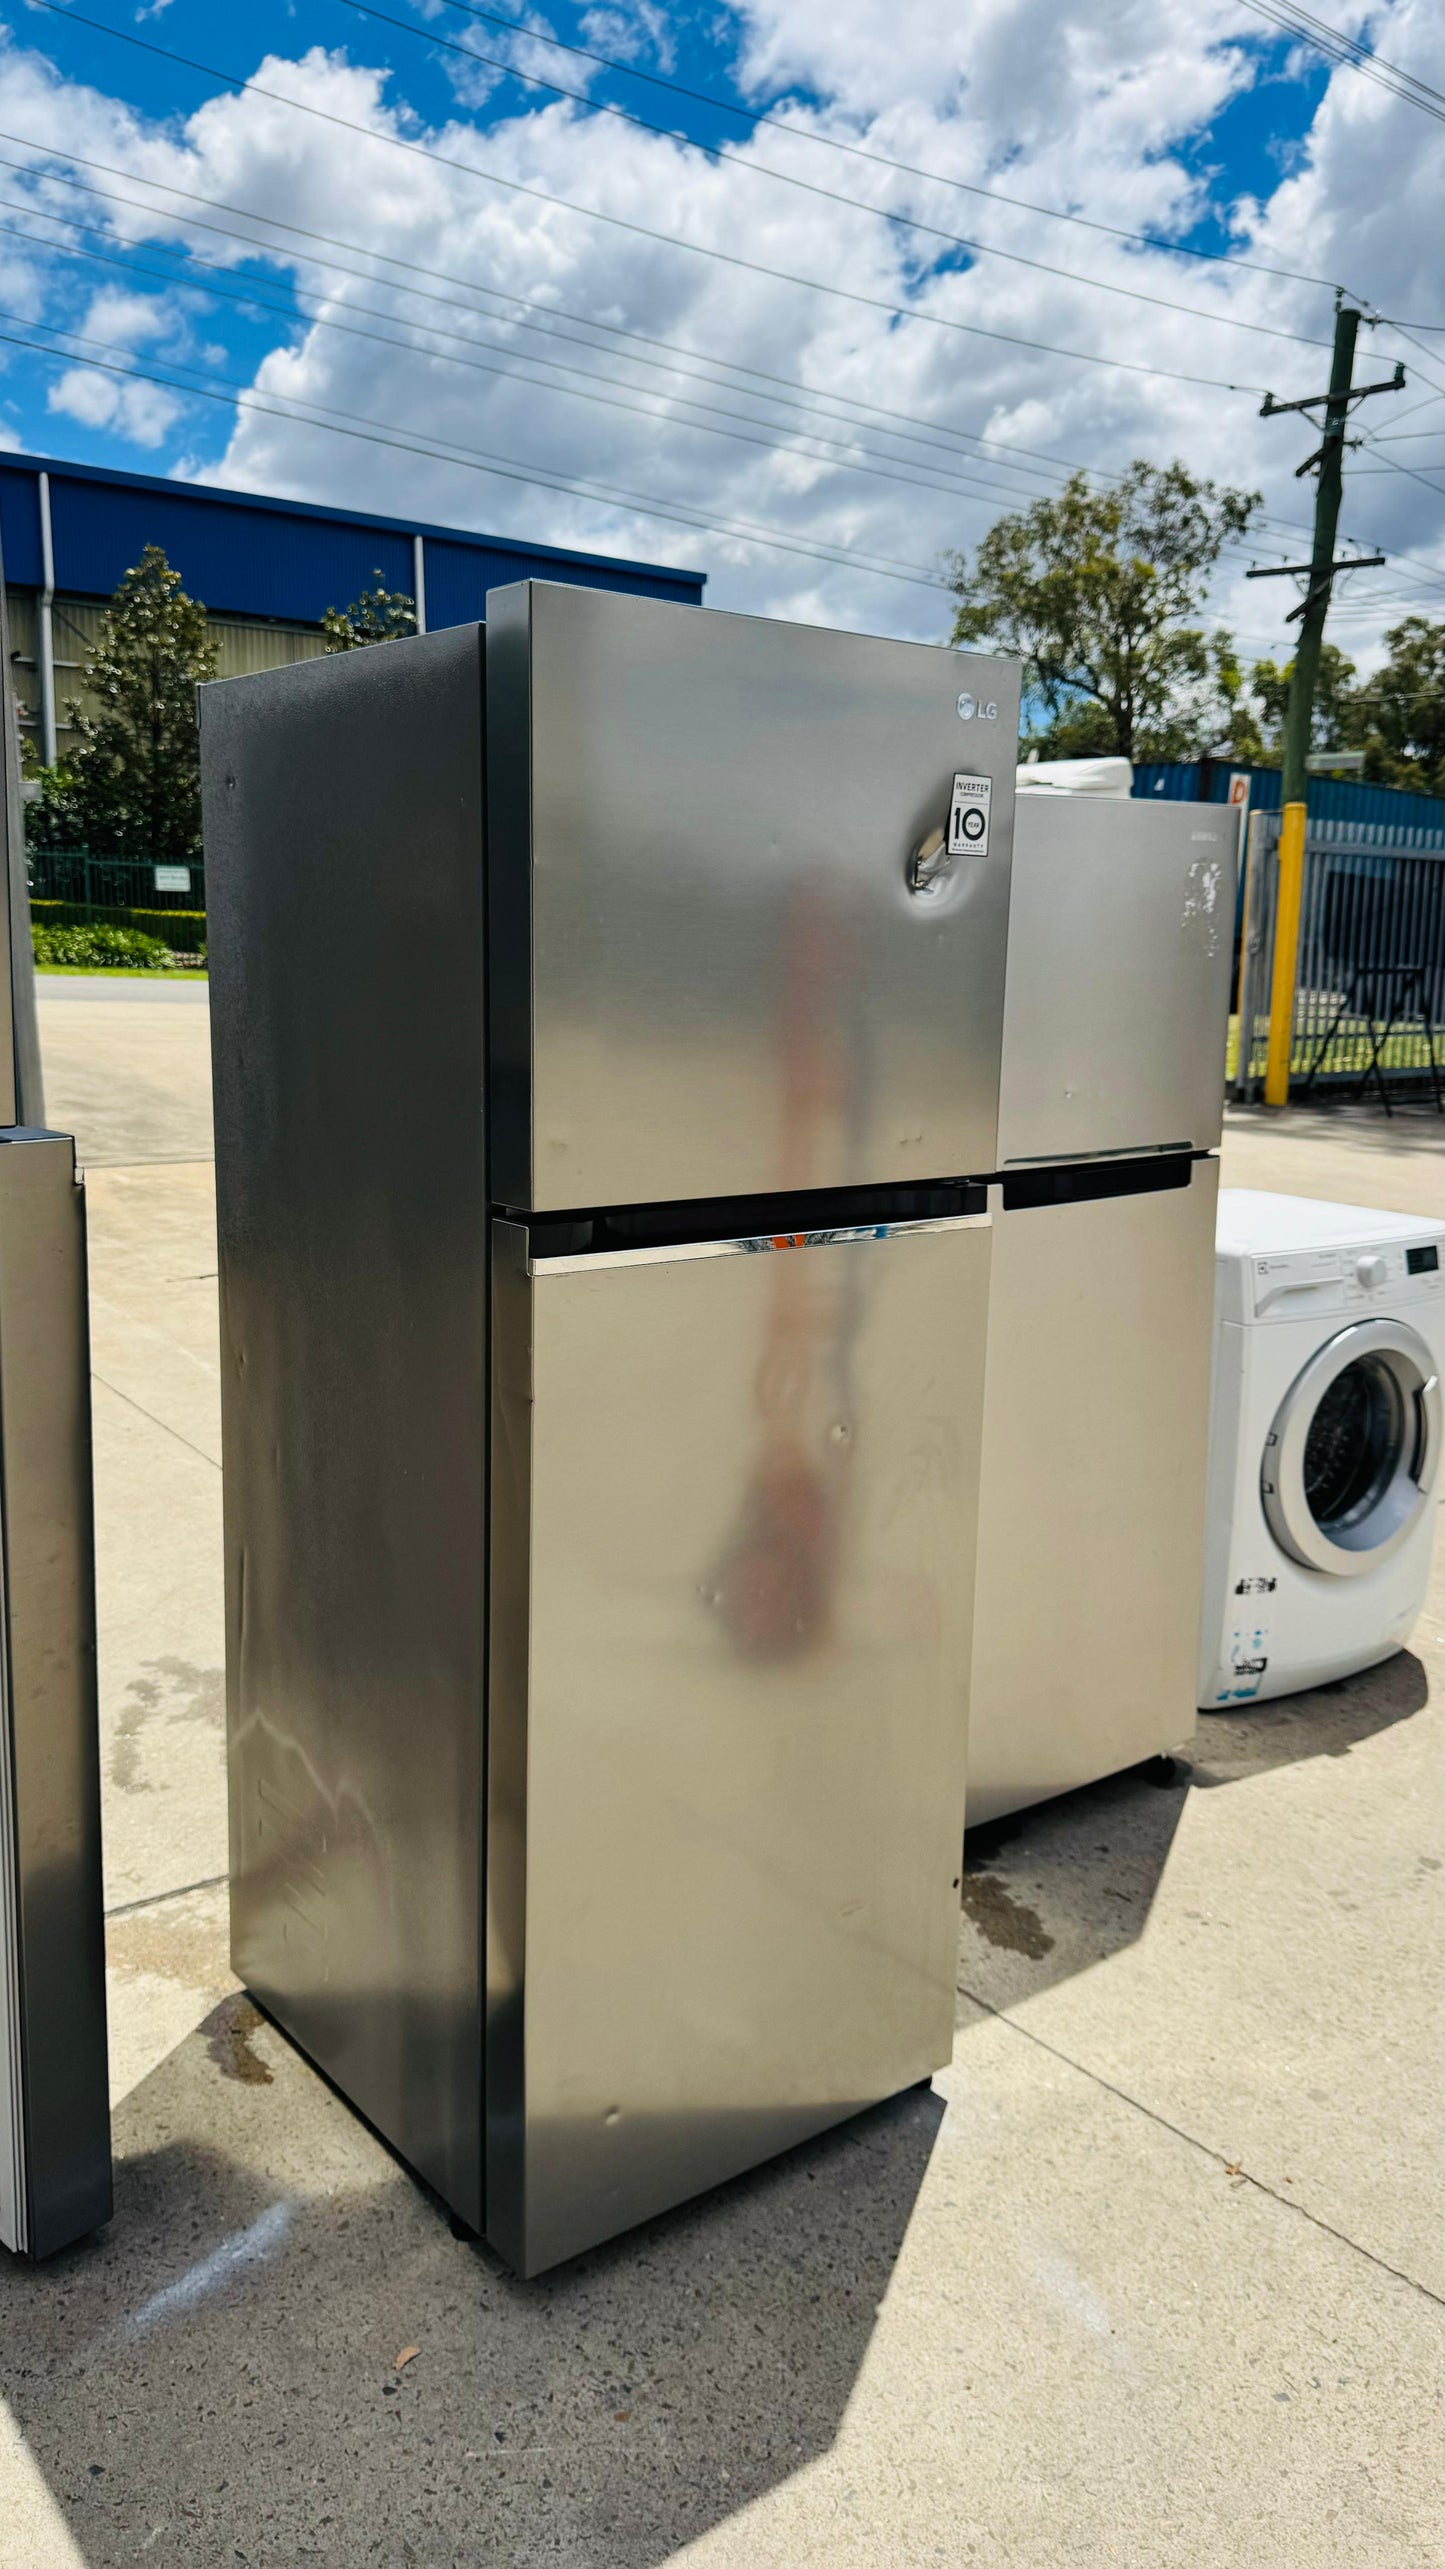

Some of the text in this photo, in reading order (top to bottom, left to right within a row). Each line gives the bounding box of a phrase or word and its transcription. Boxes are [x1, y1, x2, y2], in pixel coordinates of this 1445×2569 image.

[977, 700, 998, 720] LG
[956, 781, 989, 793] INVERTER
[954, 807, 986, 841] 10
